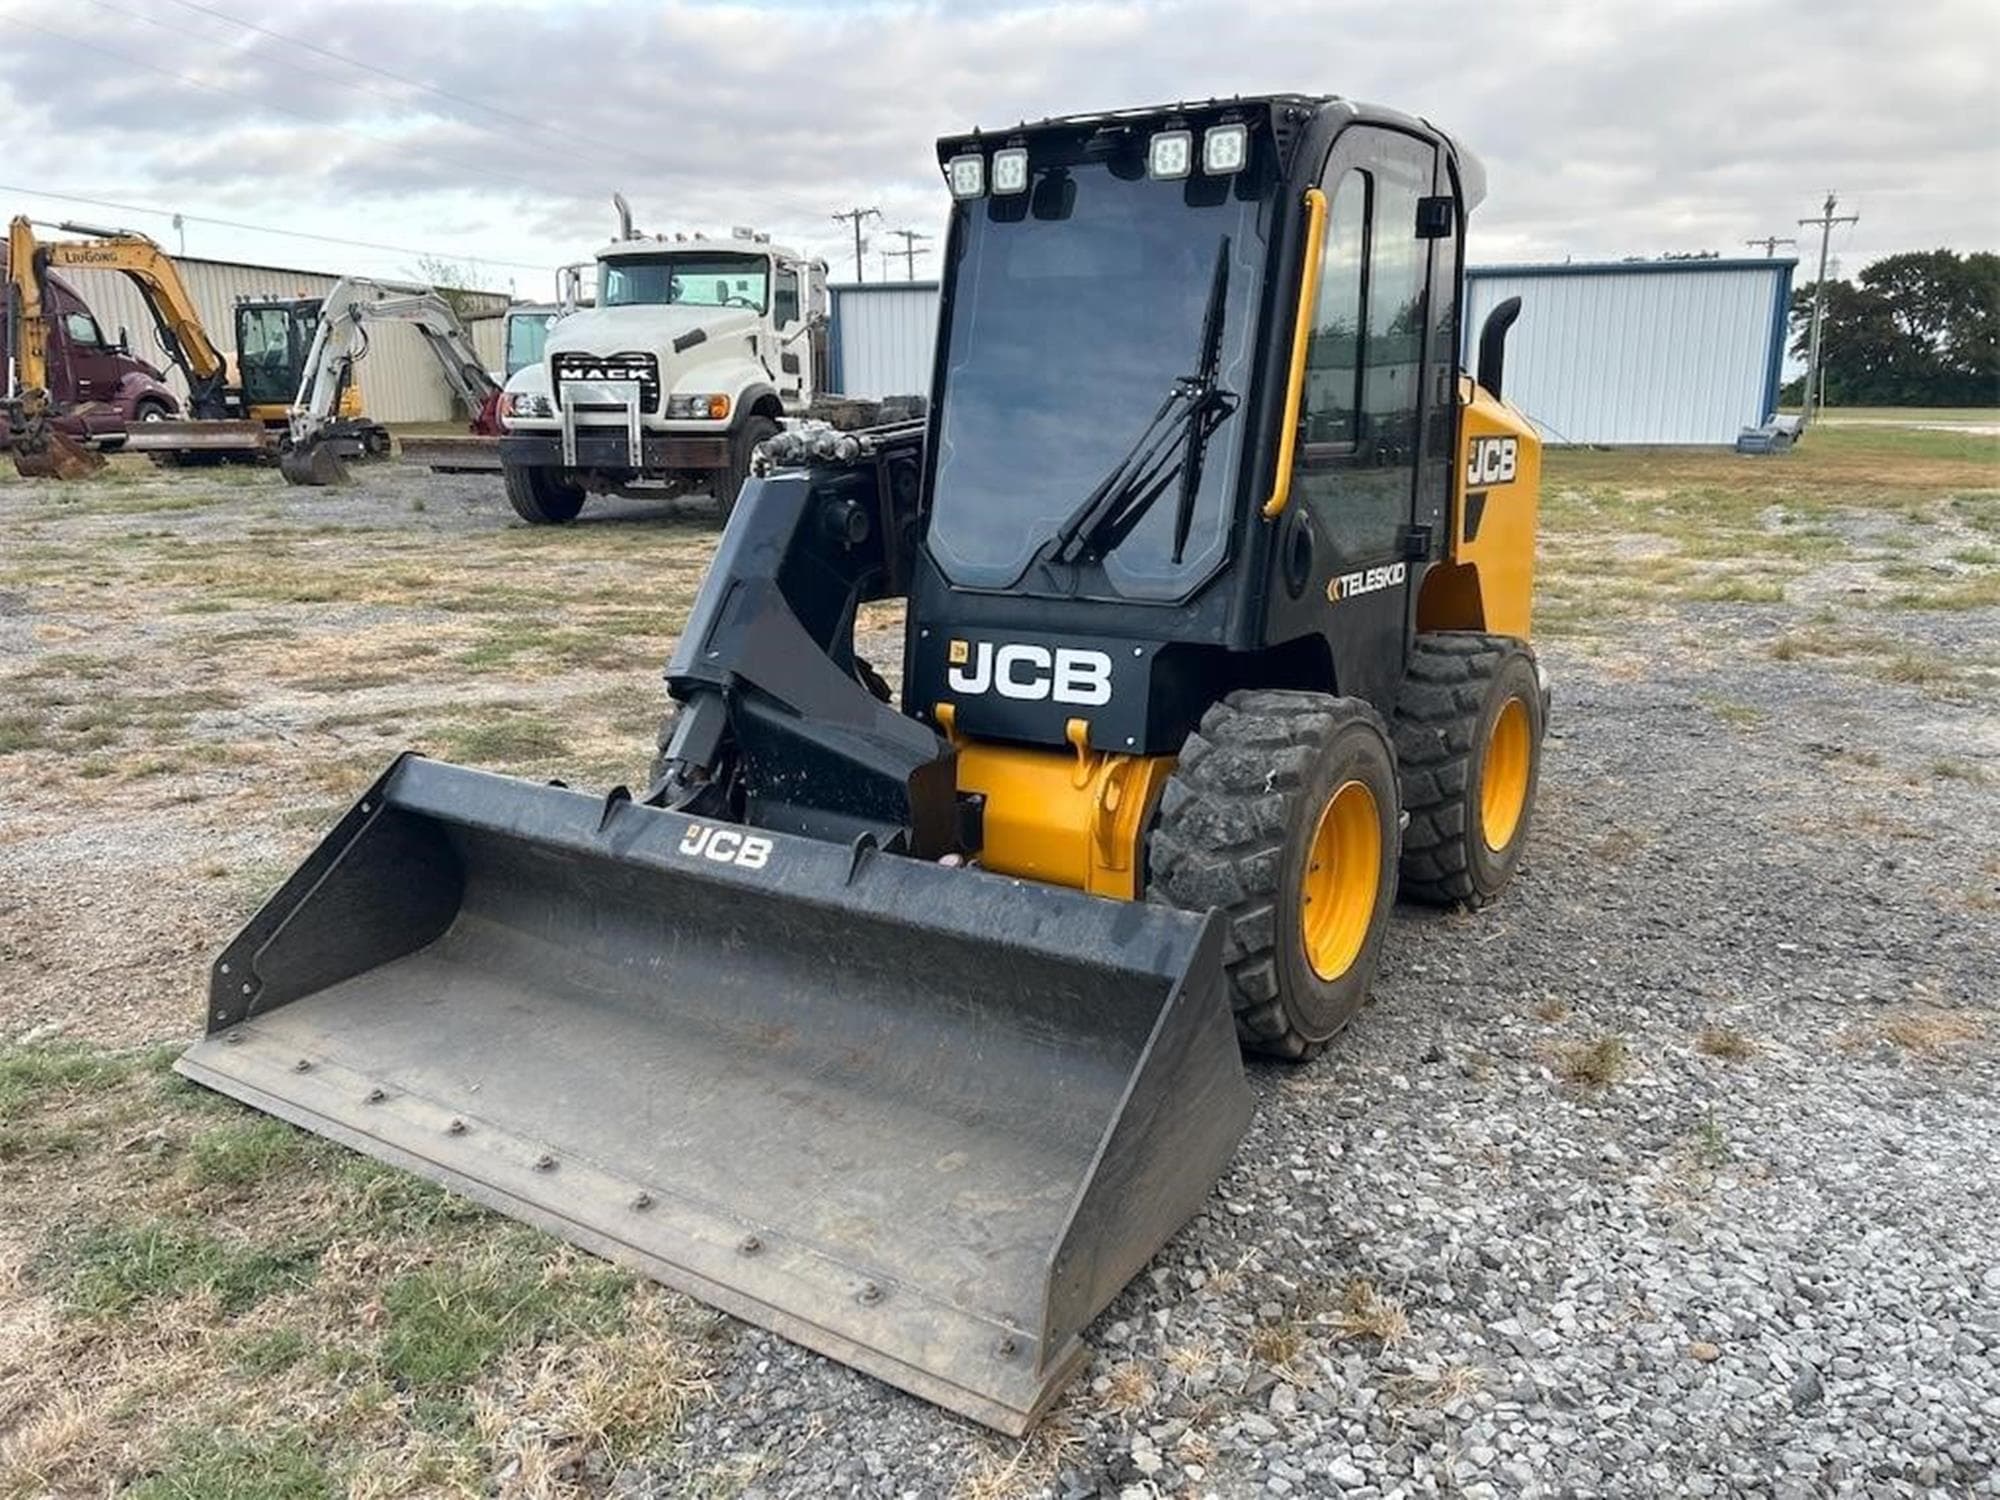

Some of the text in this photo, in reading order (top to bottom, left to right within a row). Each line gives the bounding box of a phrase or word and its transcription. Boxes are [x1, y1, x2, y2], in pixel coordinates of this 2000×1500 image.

[561, 369, 651, 379] MACK
[1468, 439, 1517, 484] JCB
[1340, 562, 1405, 598] TELESKID
[948, 640, 1112, 706] JCB
[679, 825, 773, 869] JCB
